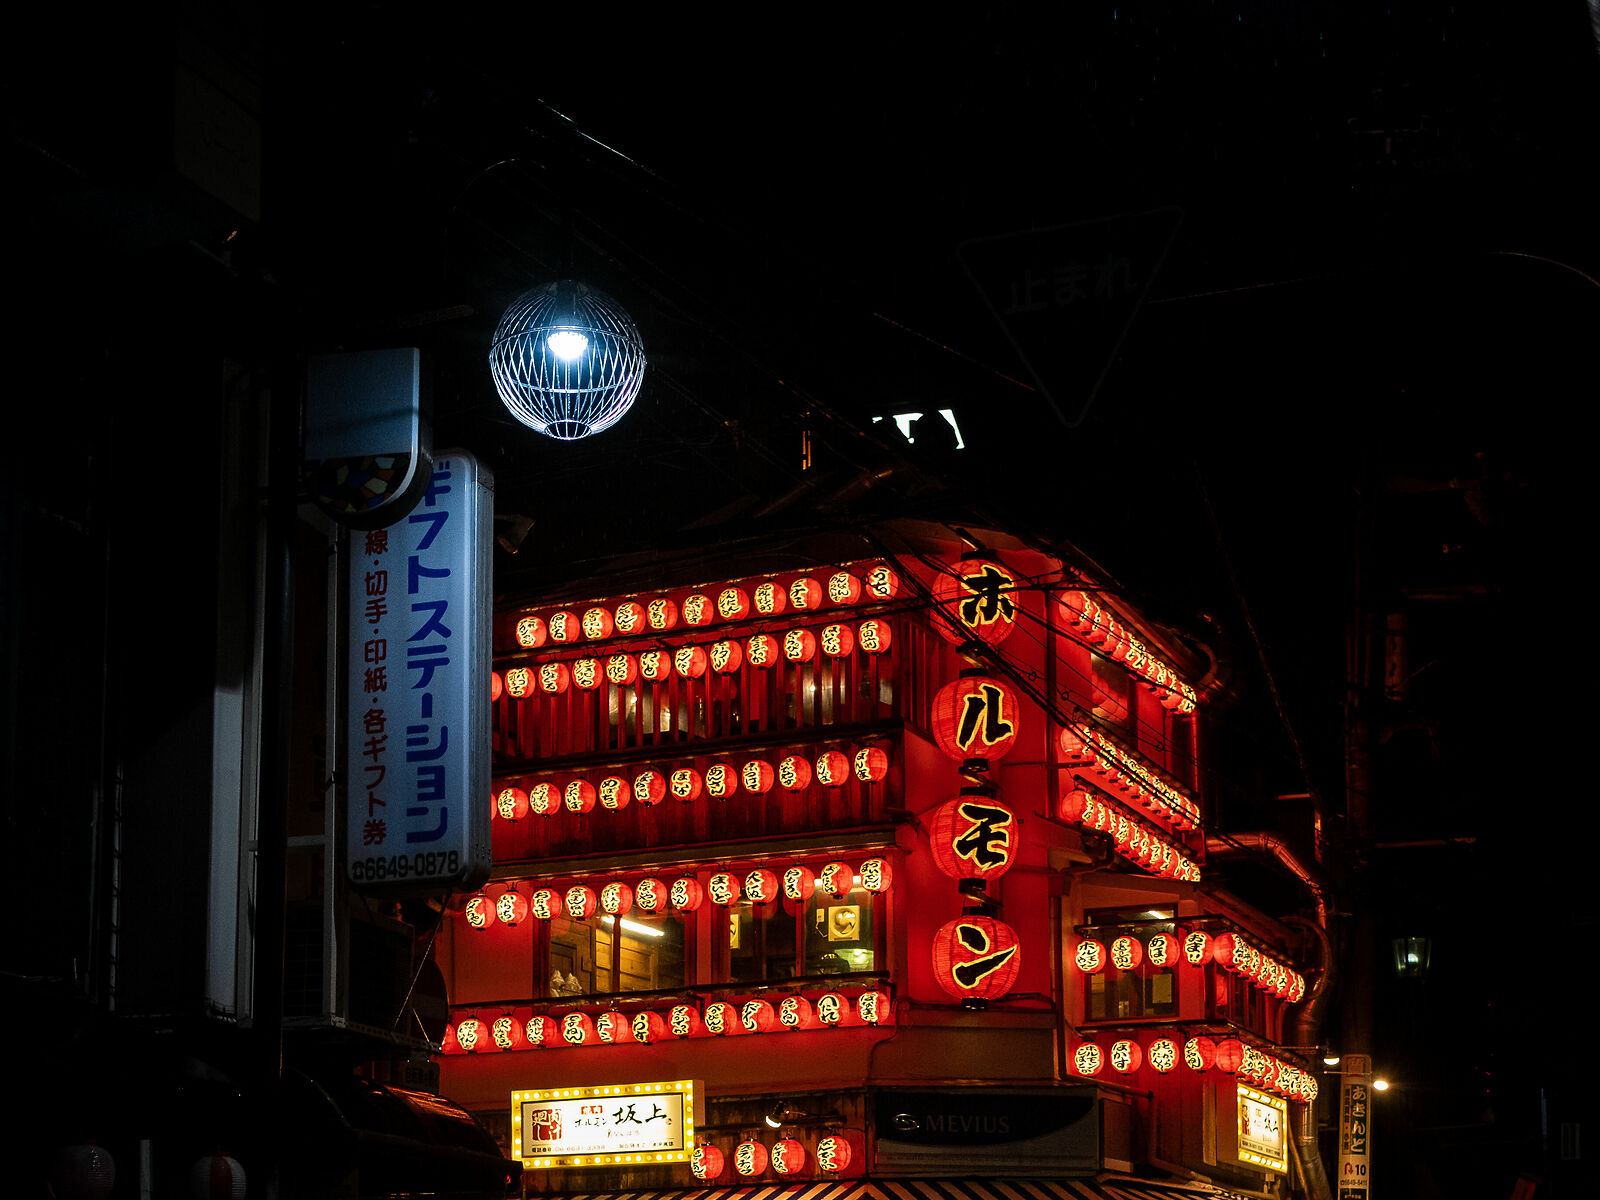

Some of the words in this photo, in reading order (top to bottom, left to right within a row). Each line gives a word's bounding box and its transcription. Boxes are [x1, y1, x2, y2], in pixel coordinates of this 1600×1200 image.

[1004, 254, 1138, 315] 止まれ
[861, 622, 878, 649] 千日前
[405, 460, 452, 844] ギフトステーション
[365, 850, 459, 881] 6649-0878
[711, 876, 731, 902] まいど
[747, 872, 765, 899] 大阪
[1112, 1042, 1130, 1069] ほかす
[575, 1118, 607, 1128] ホルモン
[613, 1104, 667, 1124] 坂上
[926, 1114, 1011, 1134] MEVIUS
[1351, 1085, 1367, 1153] あきんど
[1355, 1164, 1367, 1176] 10
